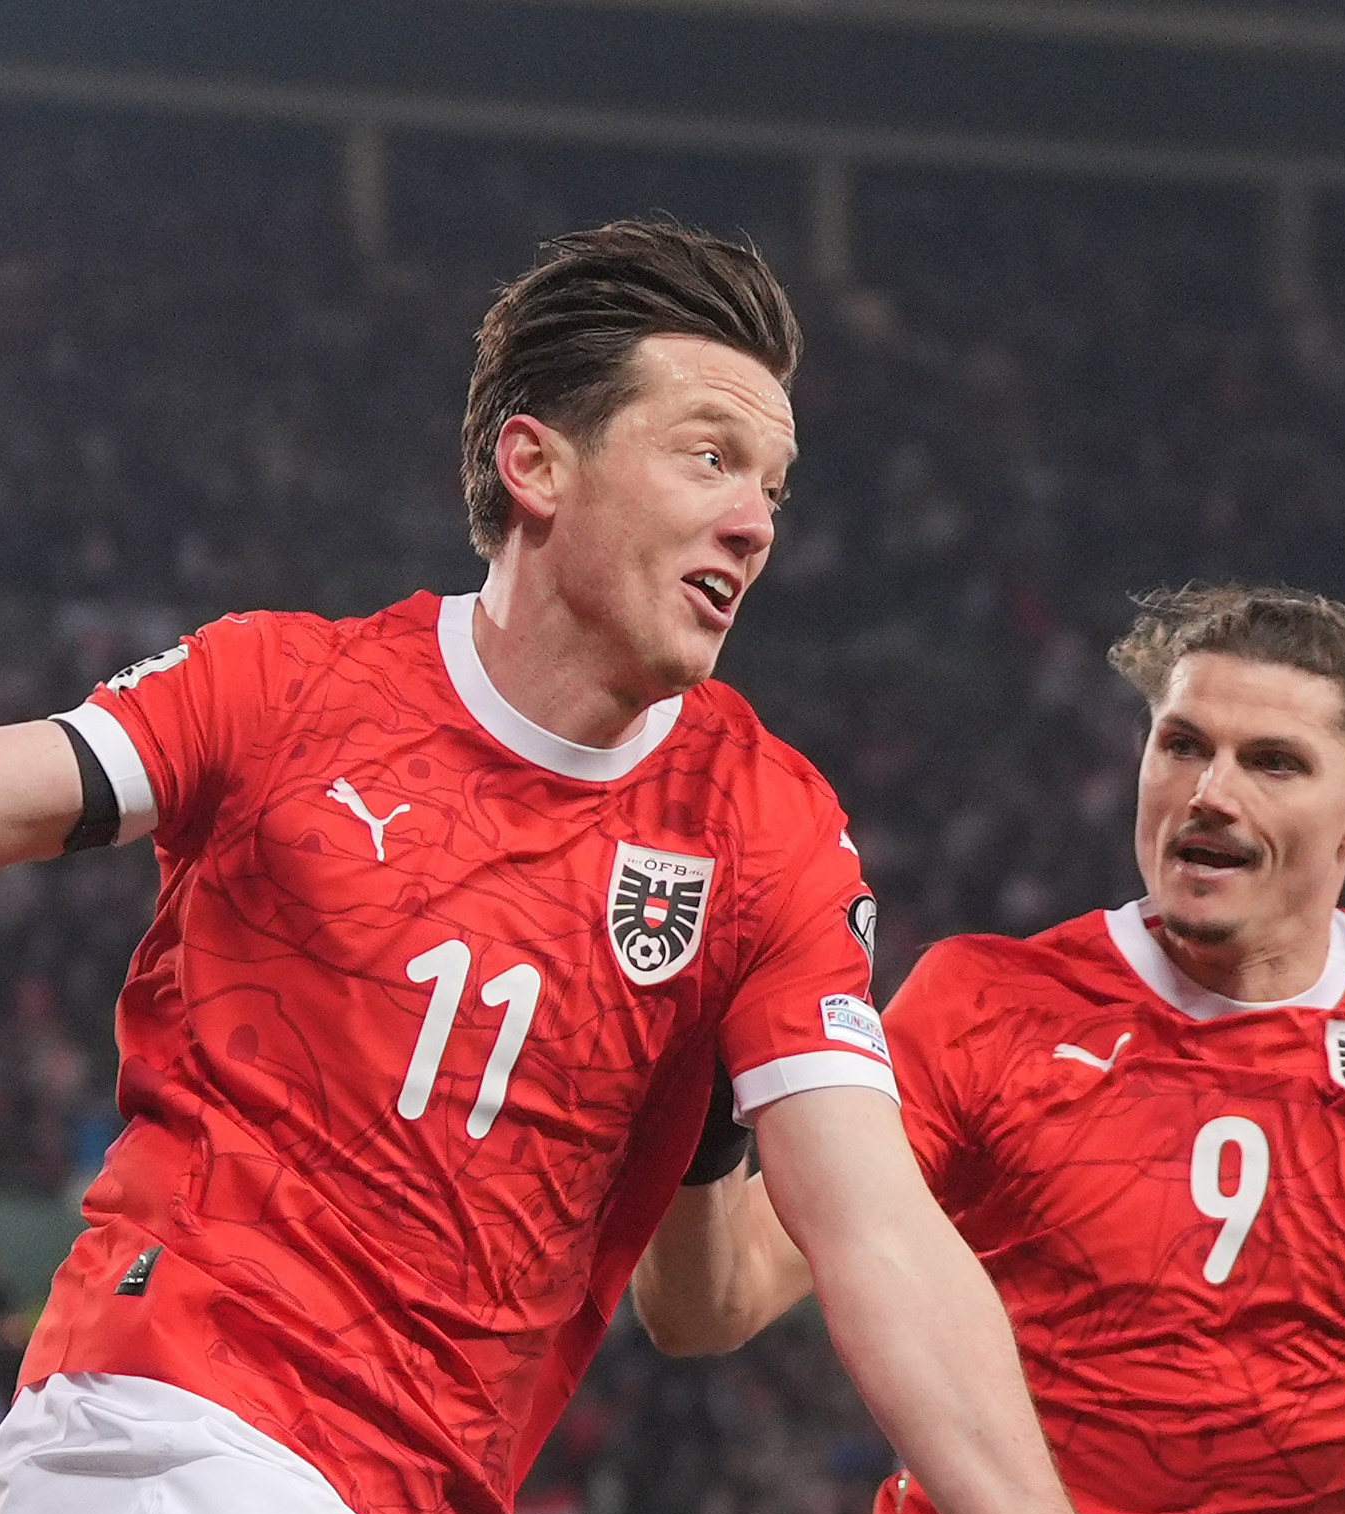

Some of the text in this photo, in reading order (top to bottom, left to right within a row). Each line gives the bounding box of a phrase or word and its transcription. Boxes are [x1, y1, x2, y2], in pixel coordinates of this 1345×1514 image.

[644, 856, 687, 876] ÖFB
[397, 939, 541, 1139] 11
[825, 997, 849, 1007] UEFA
[1190, 1116, 1270, 1284] 9
